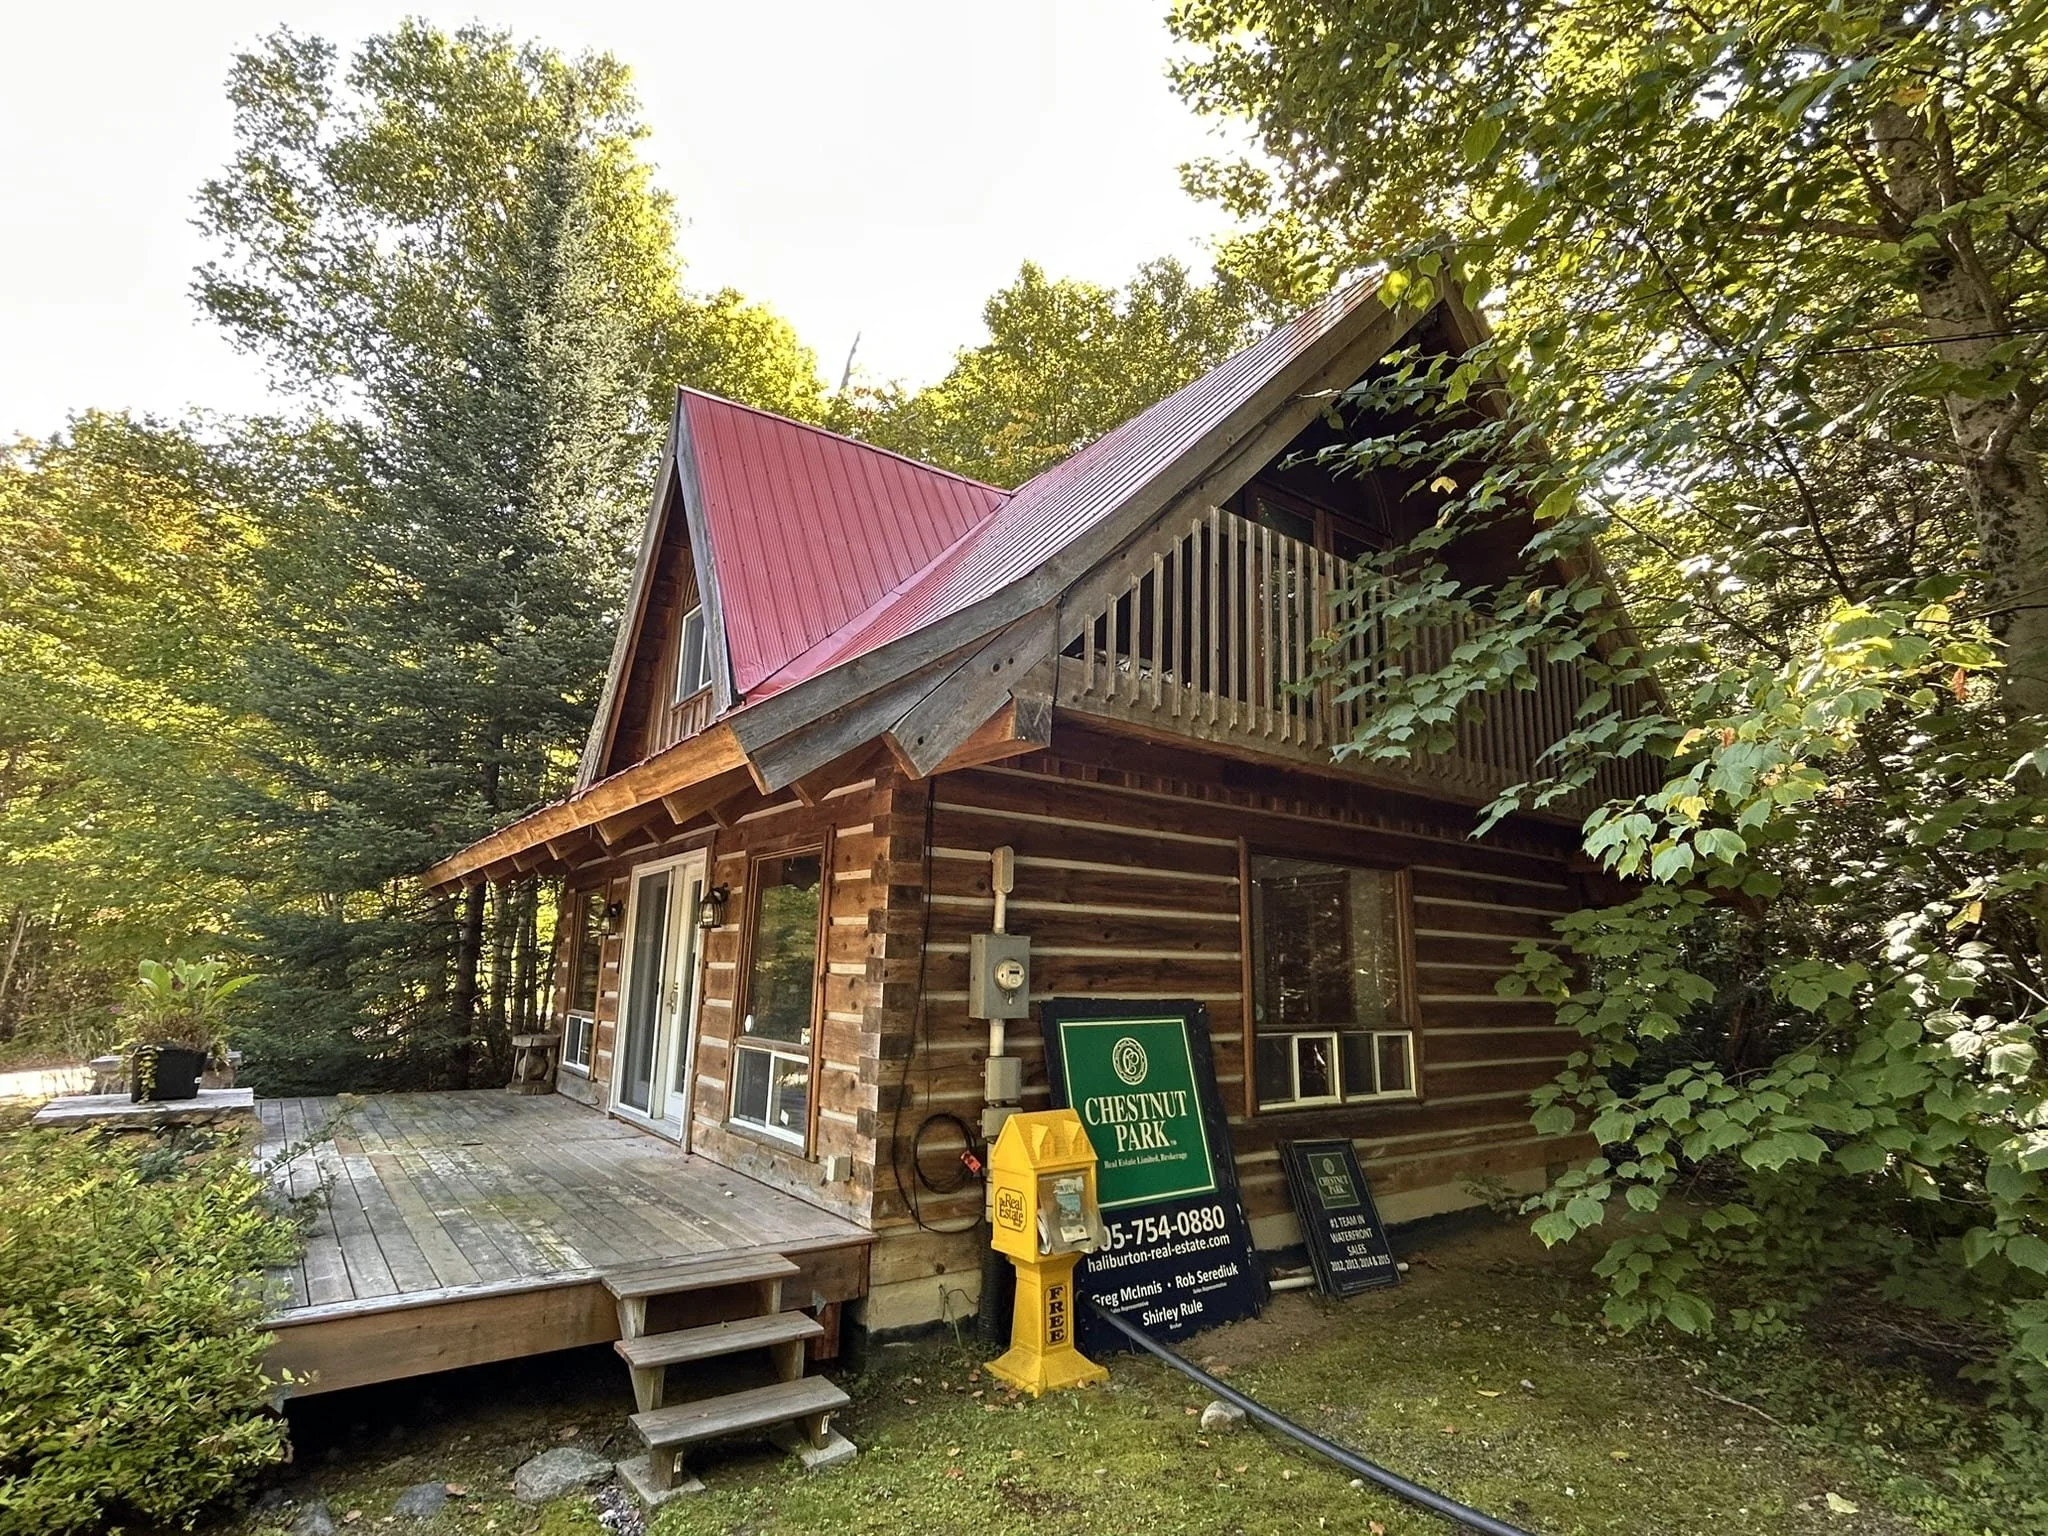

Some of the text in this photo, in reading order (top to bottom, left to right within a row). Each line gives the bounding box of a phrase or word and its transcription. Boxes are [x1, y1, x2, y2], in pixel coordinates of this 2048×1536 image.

[1084, 1090, 1188, 1126] CHESTNUT
[1114, 1120, 1171, 1153] PARK
[999, 1206, 1024, 1224] Estate
[1005, 1192, 1023, 1212] Real
[1101, 1205, 1226, 1252] 05-754-0880
[1330, 1227, 1373, 1243] WATERFRONT
[1338, 1215, 1357, 1227] TEAM
[1356, 1214, 1366, 1225] IN
[1087, 1234, 1231, 1273] haliburton-real-estate.com
[1346, 1243, 1367, 1257] SALES
[1120, 1280, 1163, 1302] McInnis
[1175, 1271, 1196, 1289] Rob
[1196, 1262, 1239, 1284] Serediuk
[1049, 1286, 1065, 1344] FREE
[1142, 1306, 1179, 1326] Shirley
[1180, 1299, 1204, 1317] Rule
